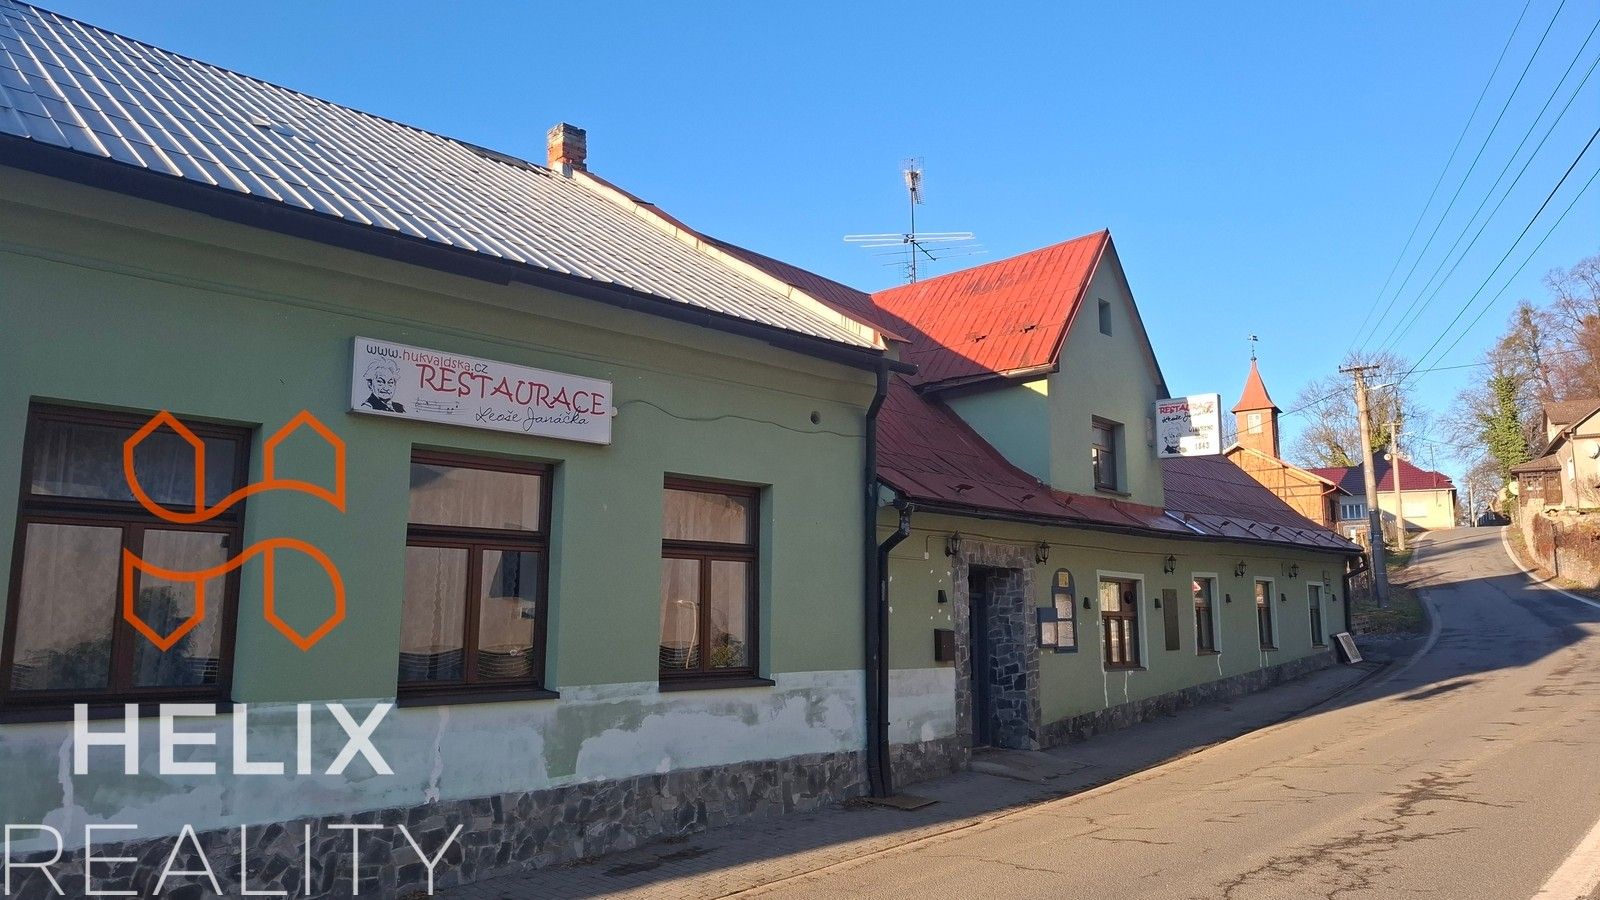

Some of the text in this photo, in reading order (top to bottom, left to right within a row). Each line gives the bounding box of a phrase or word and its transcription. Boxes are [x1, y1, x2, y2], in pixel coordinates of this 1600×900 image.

[366, 344, 488, 374] www.hukvaldska.cz
[415, 364, 606, 415] RESTAURACE
[475, 406, 589, 431] Leoše Janáčka
